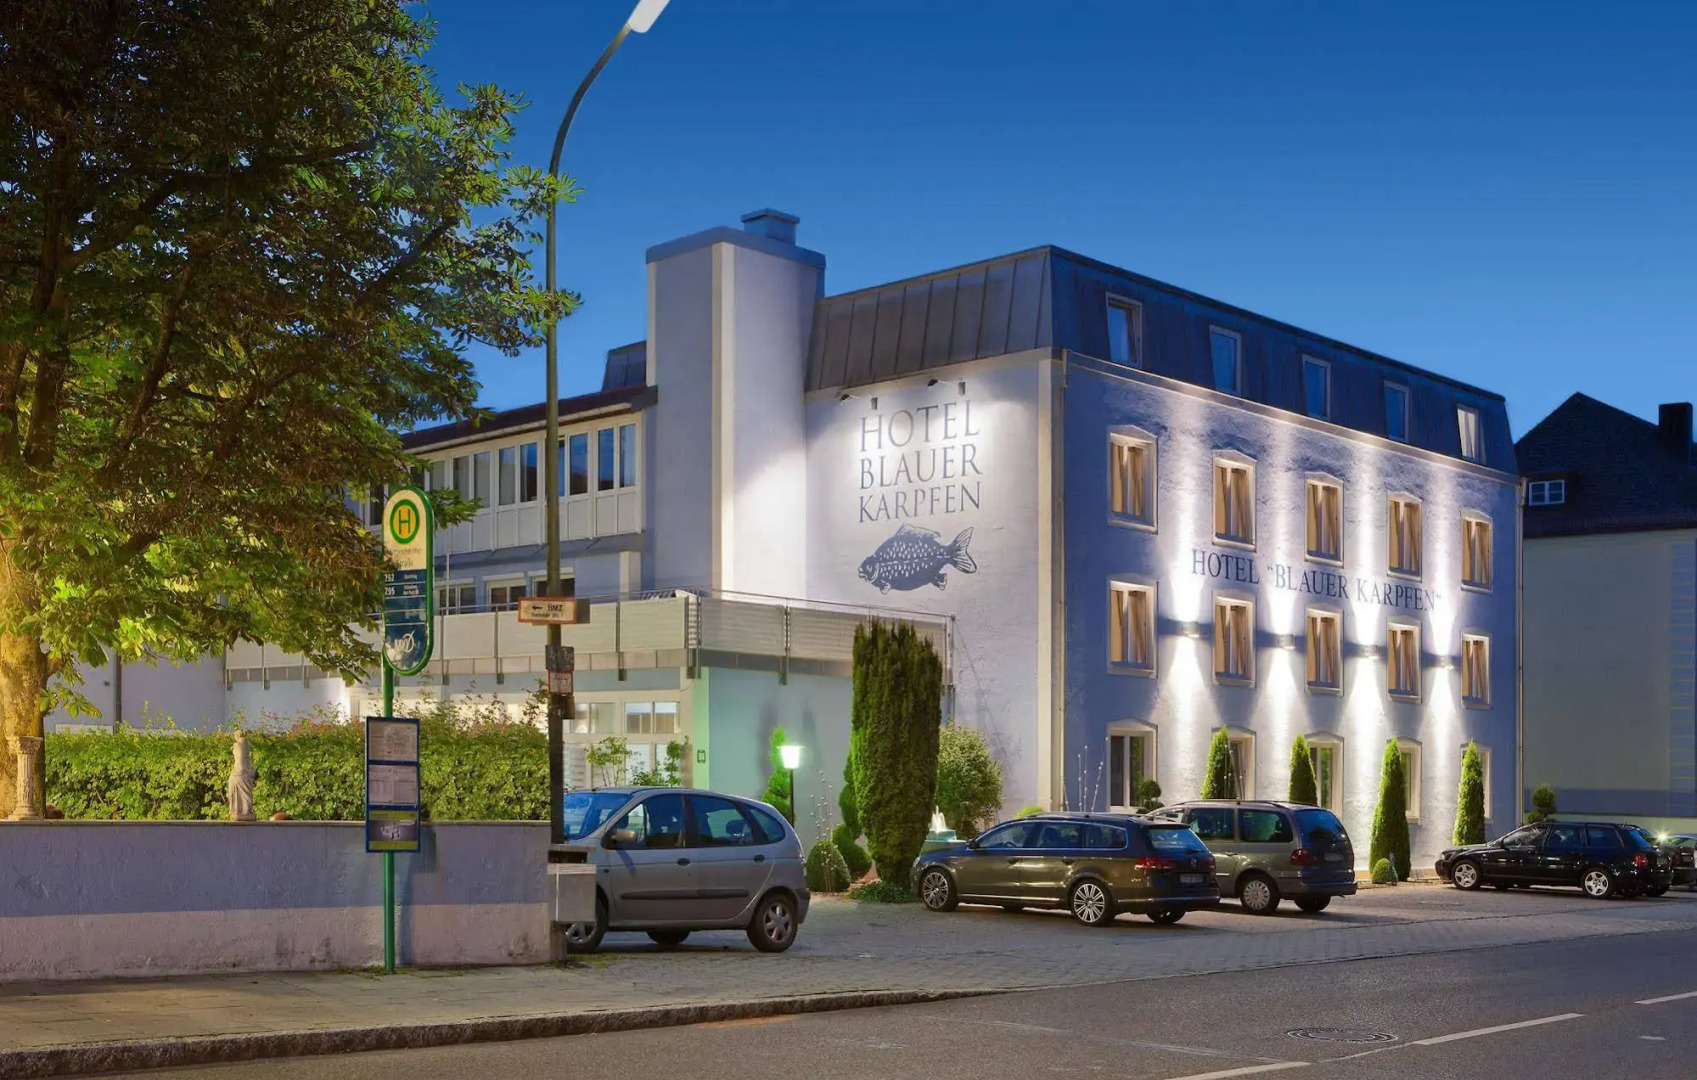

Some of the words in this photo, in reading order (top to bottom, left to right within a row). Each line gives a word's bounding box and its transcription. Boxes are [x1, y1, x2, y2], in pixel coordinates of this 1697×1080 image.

[860, 399, 980, 453] HOTEL
[860, 442, 984, 490] BLAUER
[398, 508, 411, 535] H
[859, 481, 981, 523] KARPFEN
[1192, 549, 1259, 584] HOTEL
